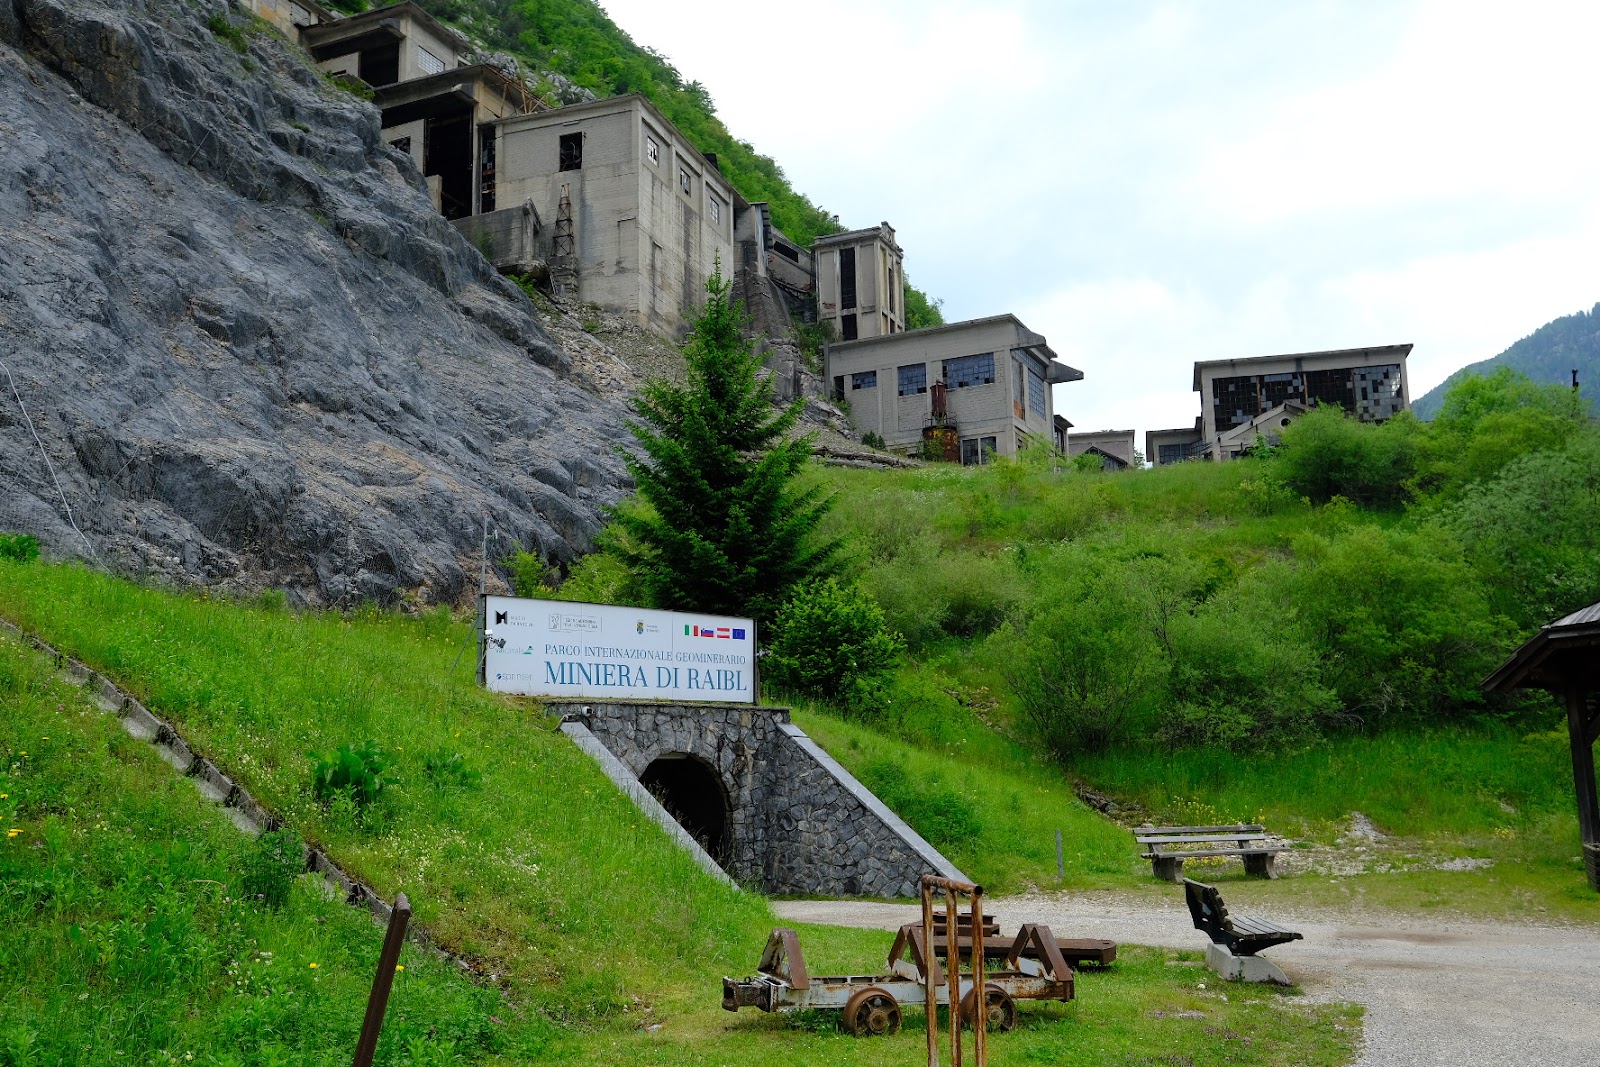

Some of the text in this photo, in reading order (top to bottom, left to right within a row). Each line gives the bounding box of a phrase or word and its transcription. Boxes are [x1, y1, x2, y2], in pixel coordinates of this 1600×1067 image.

[545, 644, 746, 665] PARCO INTERNAZIONALE GEOMINERARIO
[544, 660, 747, 691] MINIERA DI RAIBL
